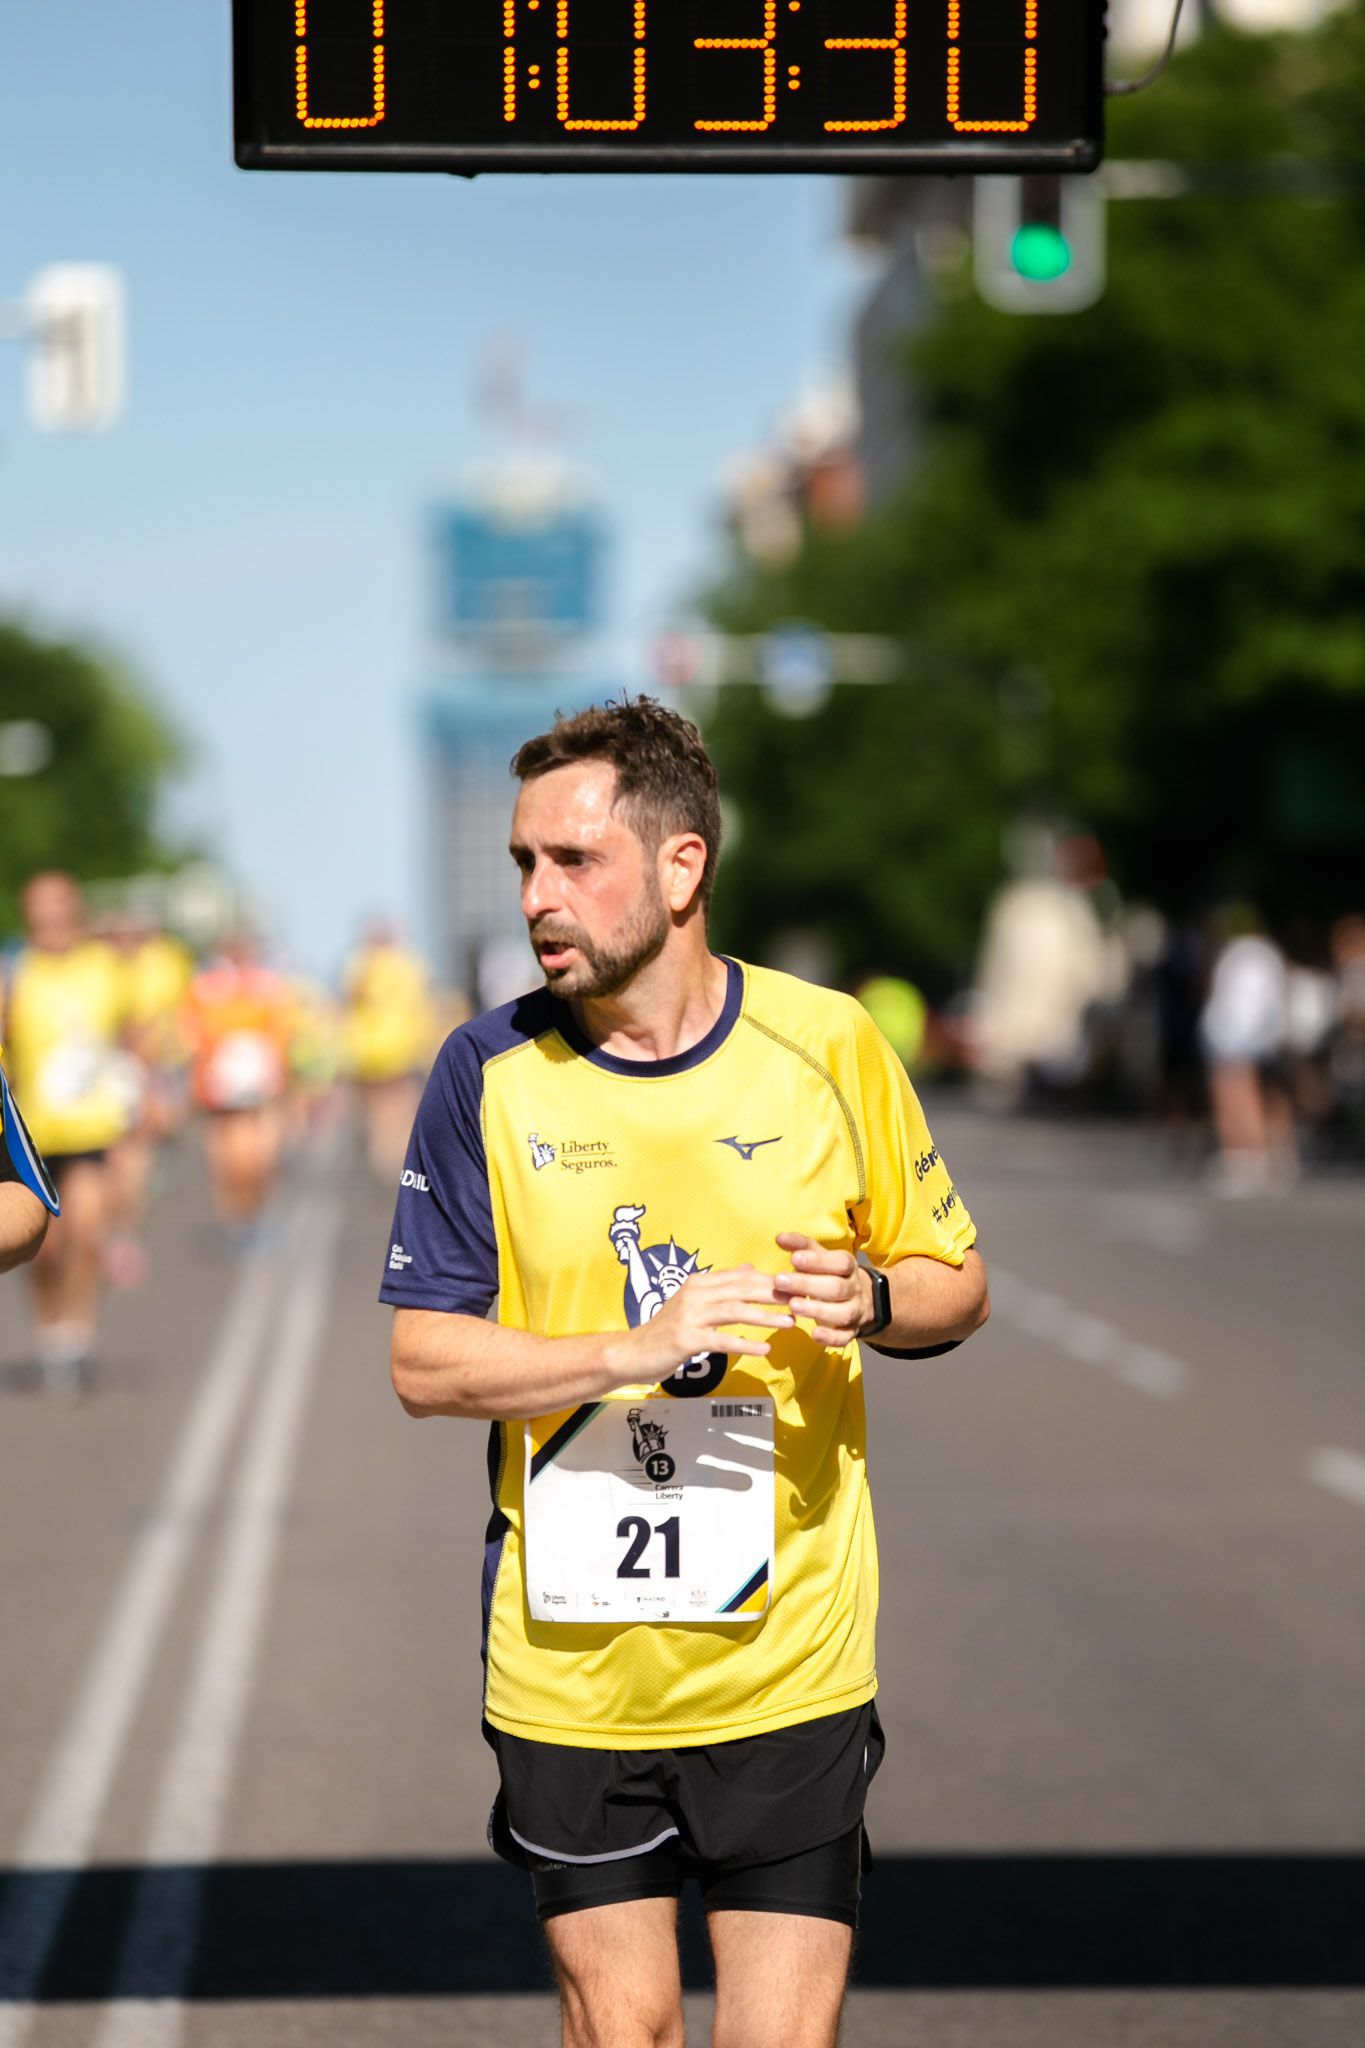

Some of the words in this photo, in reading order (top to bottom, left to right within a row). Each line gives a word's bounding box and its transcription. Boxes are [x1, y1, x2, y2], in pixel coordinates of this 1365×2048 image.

[561, 1140, 609, 1156] Liberty
[651, 1459, 670, 1476] 13
[654, 1484, 684, 1492] Carrera
[655, 1492, 684, 1501] Liberty
[616, 1515, 681, 1579] 21
